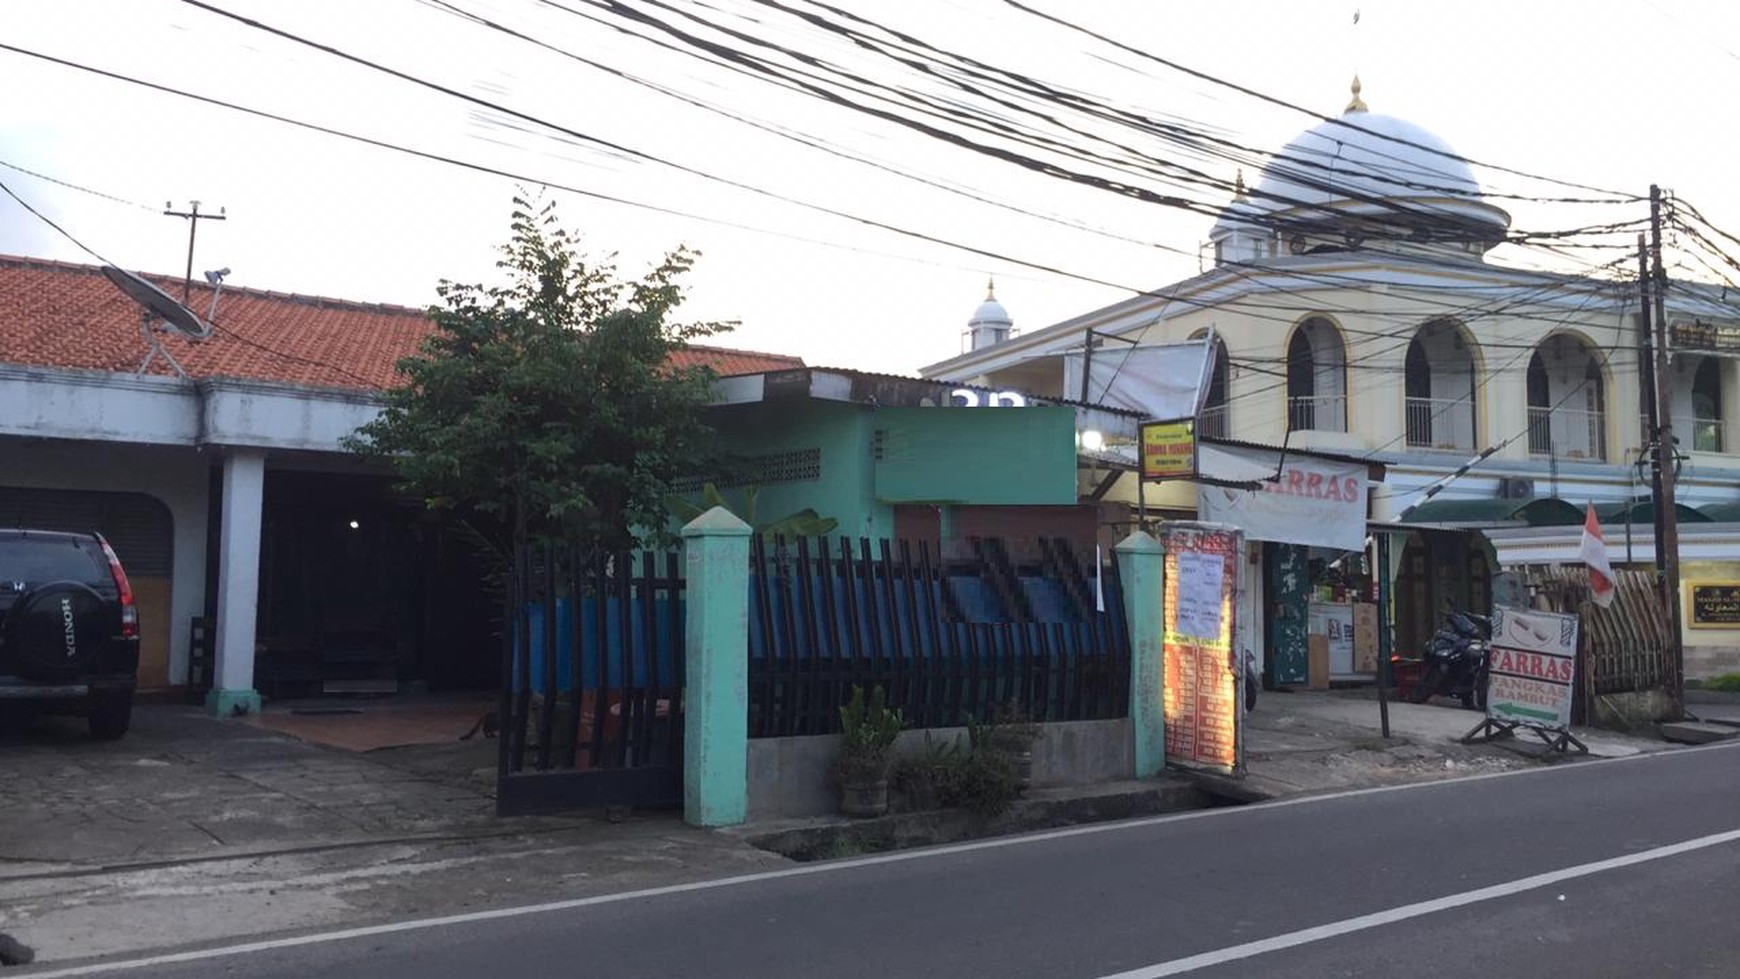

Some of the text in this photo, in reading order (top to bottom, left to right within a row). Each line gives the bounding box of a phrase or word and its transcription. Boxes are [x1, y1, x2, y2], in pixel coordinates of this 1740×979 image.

[61, 598, 76, 657] HONDA
[1489, 648, 1572, 681] FARRAS
[1490, 675, 1567, 698] PANGKAS
[1494, 687, 1558, 707] RAMBUT
